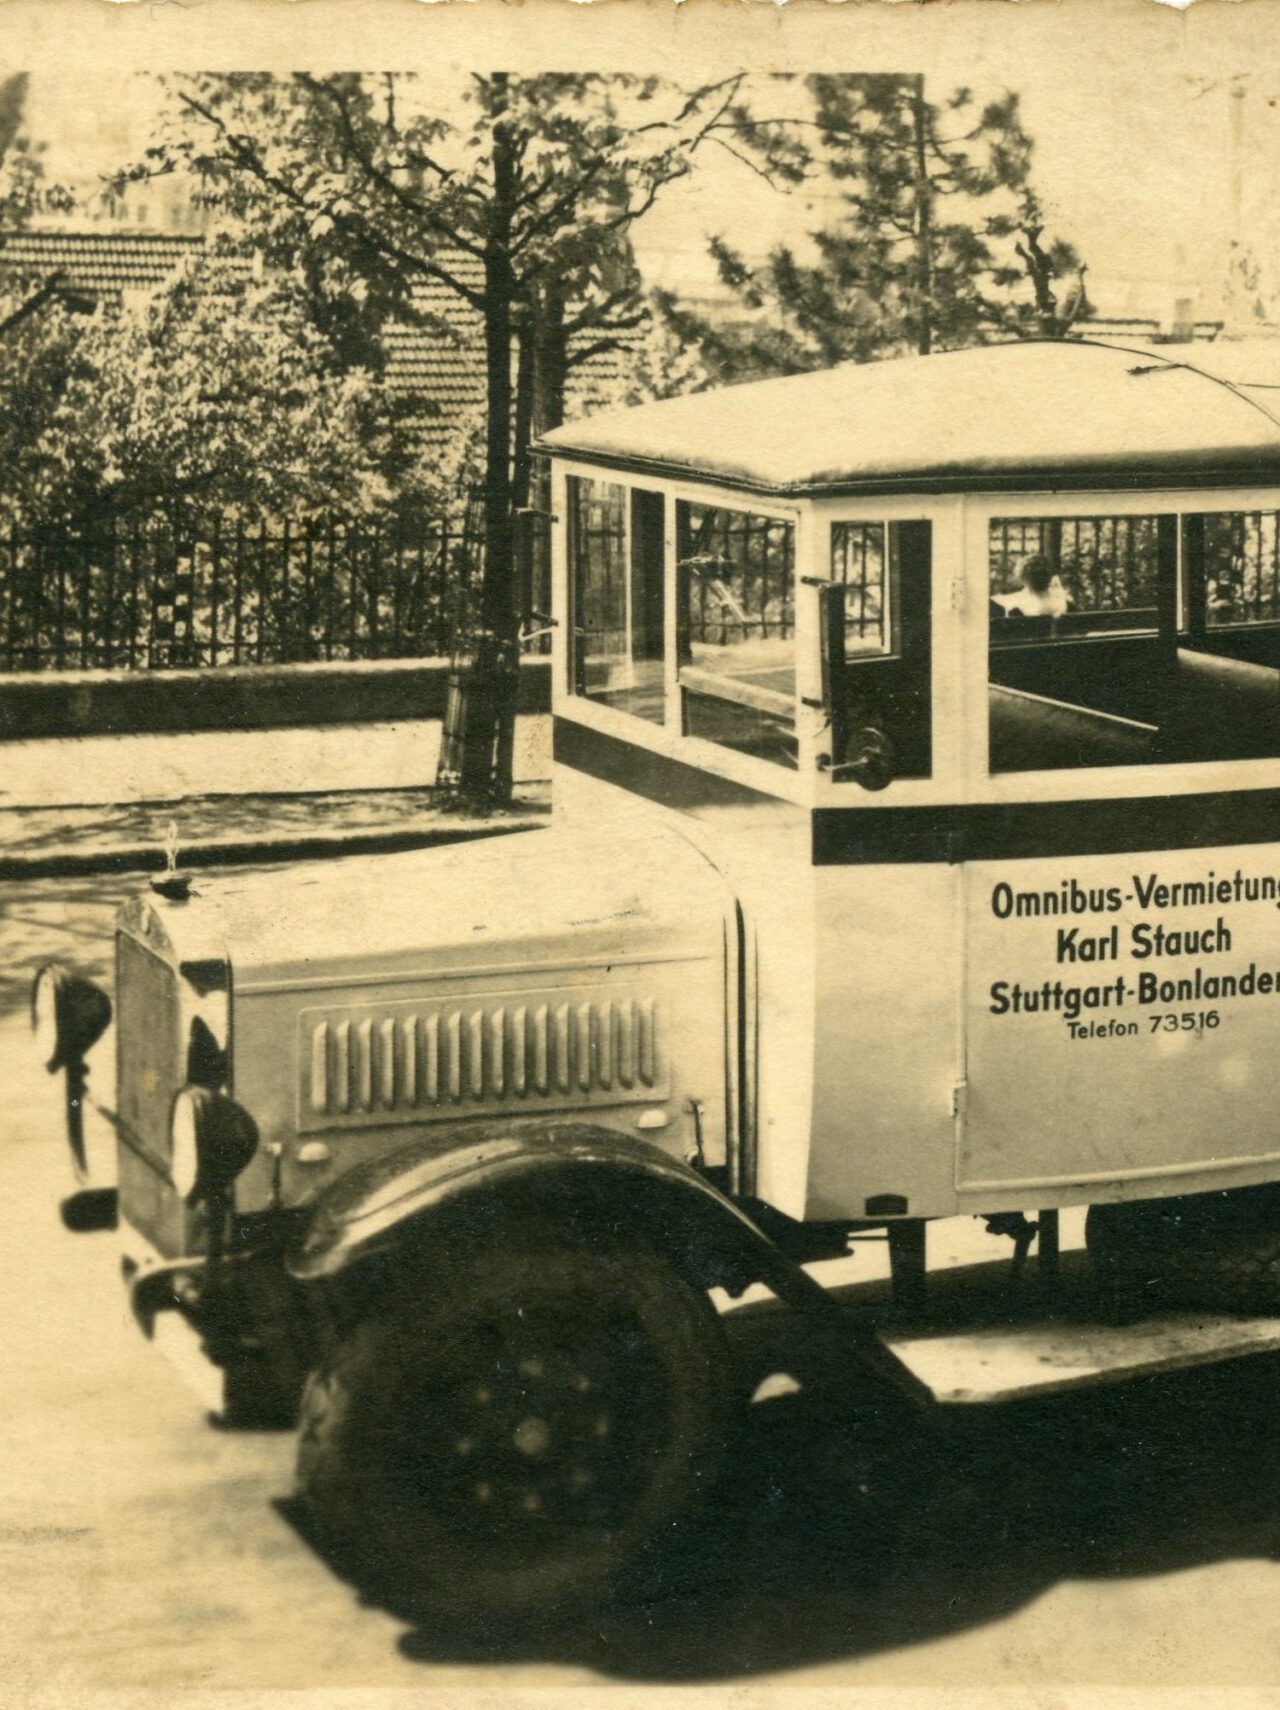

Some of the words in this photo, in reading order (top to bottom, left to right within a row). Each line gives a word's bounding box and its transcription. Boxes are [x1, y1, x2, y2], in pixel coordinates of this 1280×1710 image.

[1057, 925, 1118, 964] Karl
[1131, 917, 1231, 959] Stauch
[1067, 1020, 1139, 1040] Telefon
[1149, 1010, 1220, 1033] 73516
